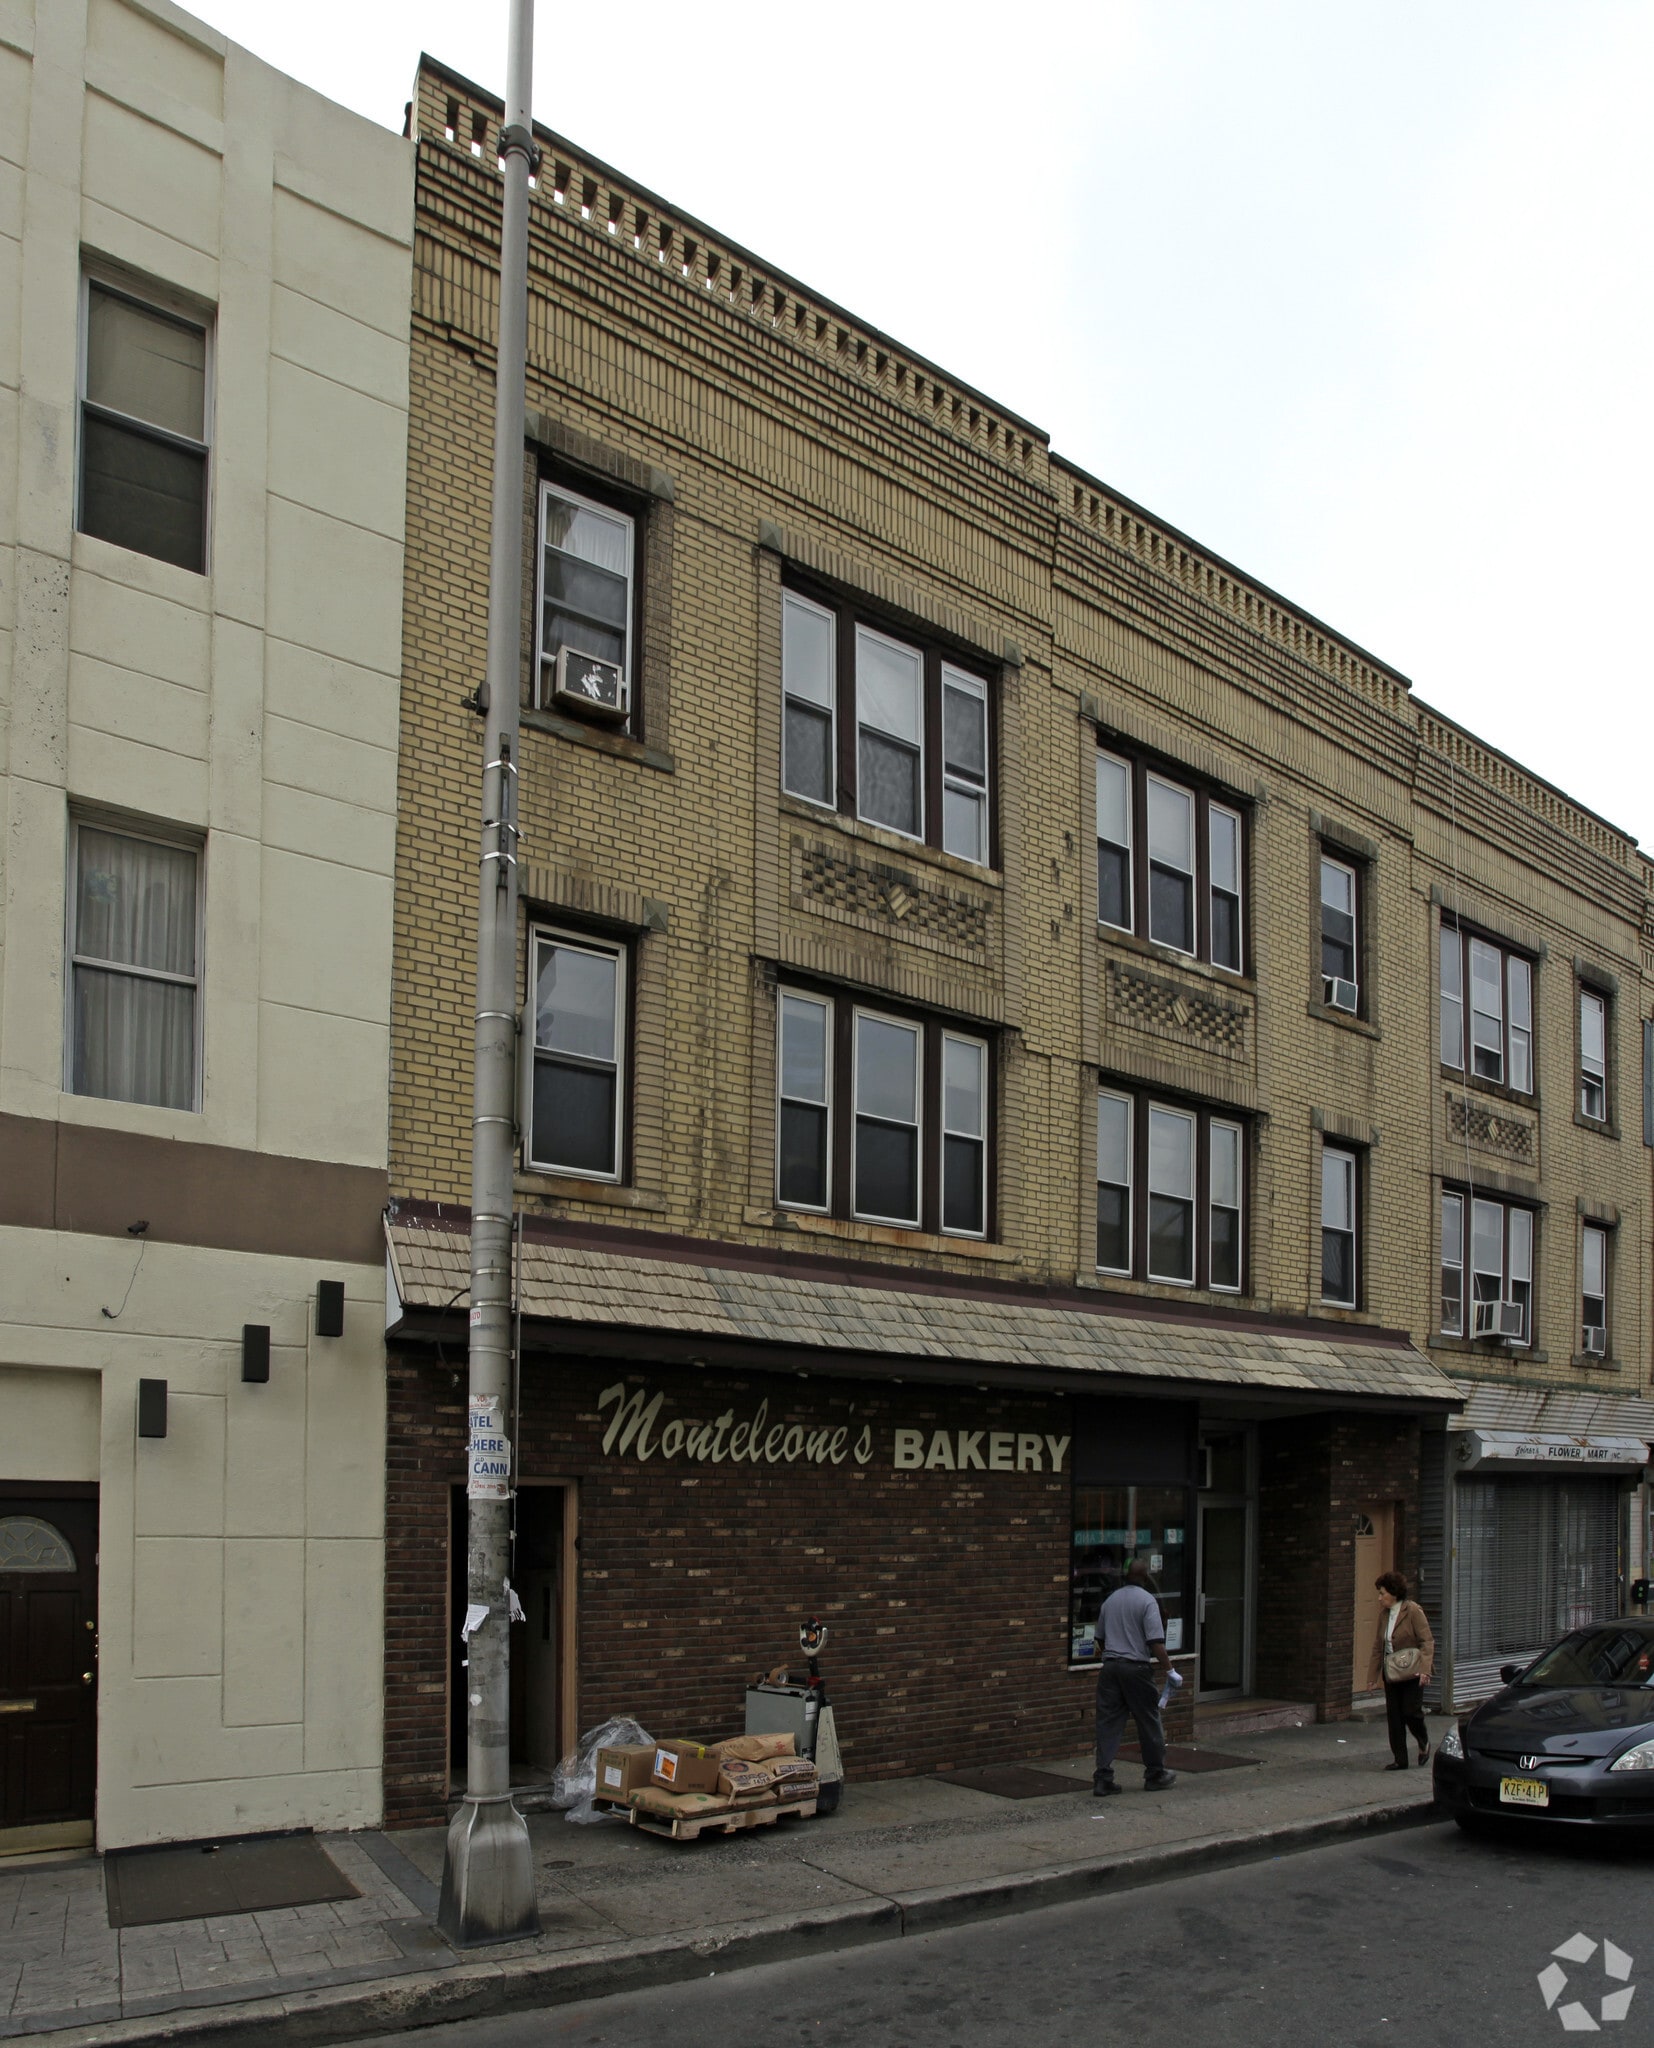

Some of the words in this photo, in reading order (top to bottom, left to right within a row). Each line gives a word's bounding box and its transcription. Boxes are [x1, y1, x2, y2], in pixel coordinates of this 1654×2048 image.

[599, 1382, 873, 1465] Monteleone's
[894, 1428, 1072, 1473] BAKERY
[1548, 1446, 1580, 1457] FLOWER
[1587, 1449, 1609, 1459] MART
[474, 1461, 508, 1475] CANN
